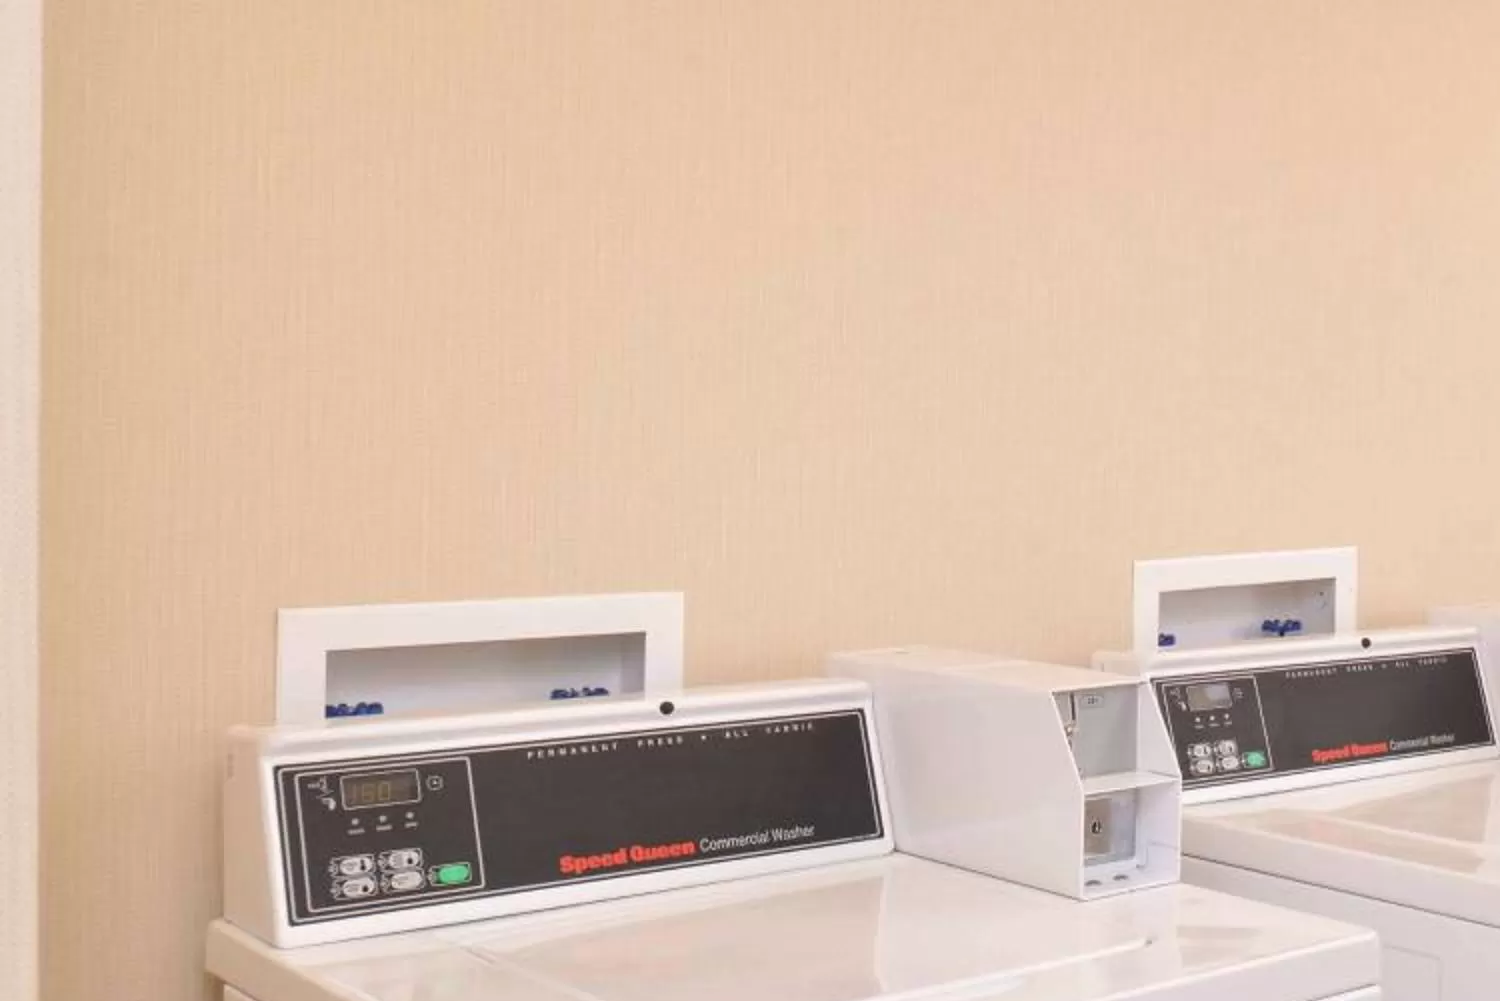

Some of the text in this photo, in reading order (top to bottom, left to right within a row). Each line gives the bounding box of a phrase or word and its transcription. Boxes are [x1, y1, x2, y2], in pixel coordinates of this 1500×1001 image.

[559, 824, 815, 874] Speed Queen Commercial Washer
